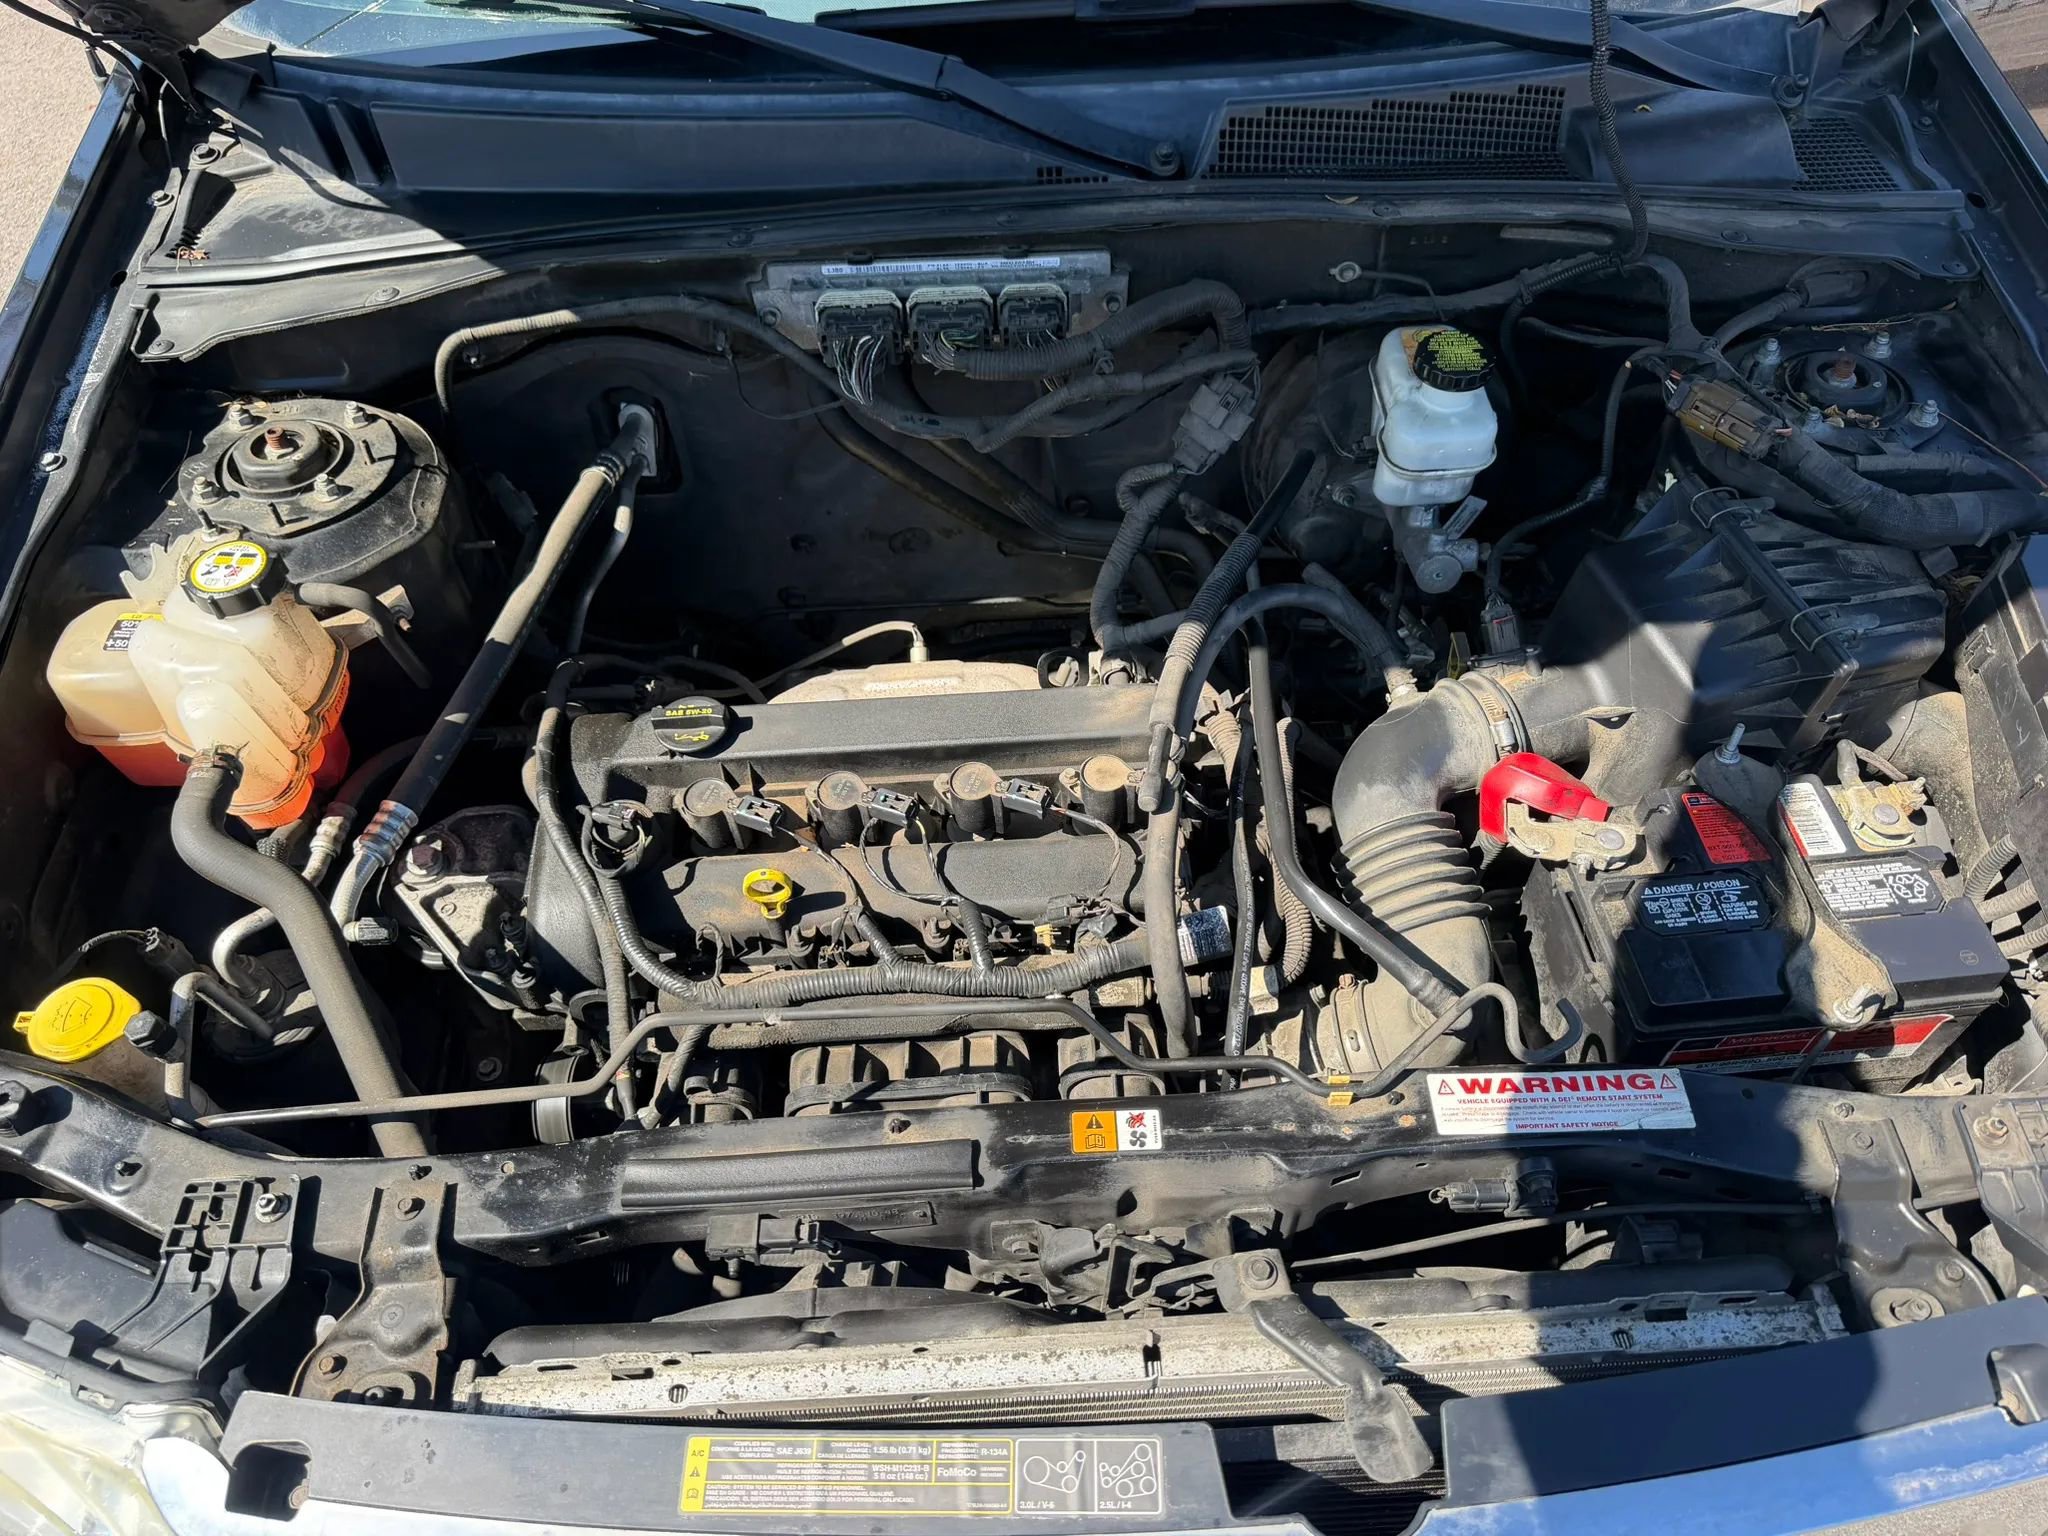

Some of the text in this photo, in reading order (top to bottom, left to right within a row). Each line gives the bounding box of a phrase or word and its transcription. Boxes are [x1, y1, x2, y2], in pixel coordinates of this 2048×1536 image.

[1653, 884, 1694, 895] DANGER
[1703, 879, 1740, 890] POISON
[1456, 1073, 1658, 1095] WARNING
[691, 1449, 705, 1457] A/C
[776, 1447, 793, 1455] SAE
[889, 1446, 897, 1454] lb
[918, 1446, 932, 1455] kg)
[981, 1448, 1008, 1456] R-134A
[937, 1466, 977, 1477] FoMoCo
[1099, 1501, 1117, 1509] 2.5L
